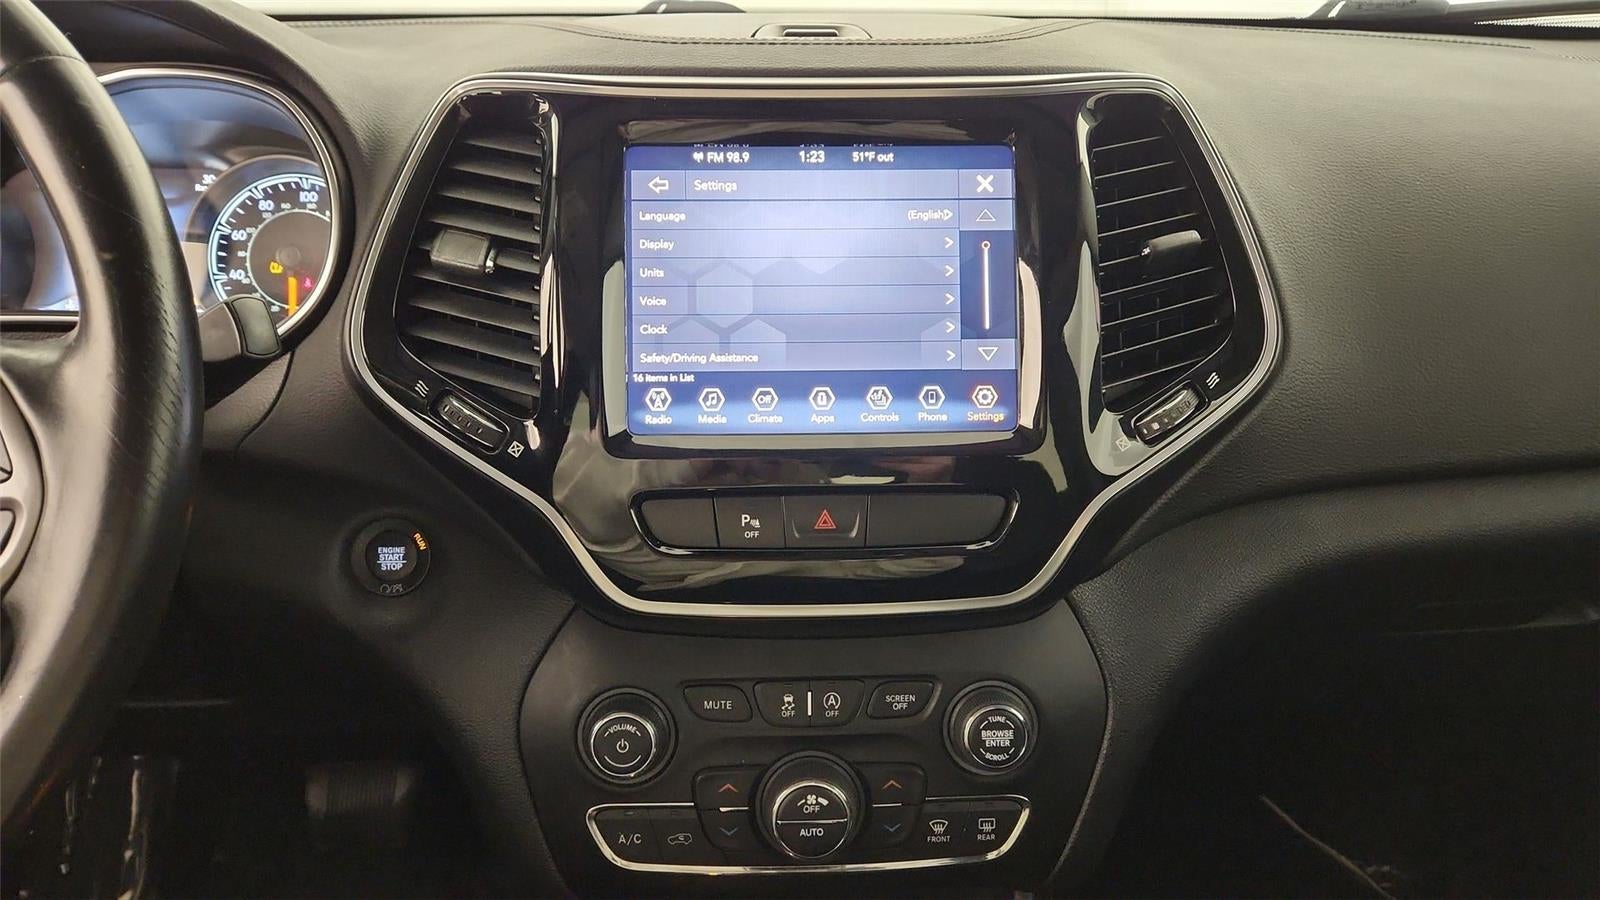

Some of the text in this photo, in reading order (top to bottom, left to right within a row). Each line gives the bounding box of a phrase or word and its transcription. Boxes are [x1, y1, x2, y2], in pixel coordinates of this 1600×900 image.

[707, 152, 750, 163] FM 98.9
[799, 150, 825, 163] 1:23
[876, 152, 894, 162] out
[694, 180, 737, 192] Settings
[299, 191, 319, 202] 100
[258, 200, 275, 210] 80
[639, 211, 686, 222] Language
[231, 230, 247, 240] 60
[639, 239, 674, 250] Display
[229, 269, 246, 280] 40
[639, 268, 665, 278] Units
[639, 296, 667, 306] Voice
[639, 324, 668, 334] Clock
[639, 353, 759, 364] Safety/Driving Assistance
[632, 373, 644, 382] 16
[669, 373, 678, 382] in
[679, 373, 695, 382] List
[645, 414, 672, 424] Radio
[698, 414, 727, 424] Media
[748, 413, 783, 424] Climate
[810, 413, 835, 424] Apps
[861, 412, 900, 422] Controls
[918, 411, 948, 421] Phone
[967, 411, 1005, 423] Settings
[413, 532, 427, 551] RUN
[378, 546, 406, 554] ENGINE
[379, 553, 404, 561] START
[380, 563, 403, 571] STOP
[885, 694, 916, 703] SCREEN
[703, 700, 733, 710] MUTE
[892, 702, 908, 711] OFF
[825, 710, 839, 718] OFF
[988, 716, 1007, 724] TUNE
[608, 723, 637, 734] VOLUME
[981, 729, 1014, 738] BROWSE
[985, 739, 1011, 747] ENTER
[984, 752, 1010, 761] SCROLL
[803, 805, 820, 814] OFF
[800, 827, 824, 837] AUTO
[977, 833, 996, 841] REAR
[618, 833, 642, 844] A/C
[927, 835, 950, 843] FRONT
